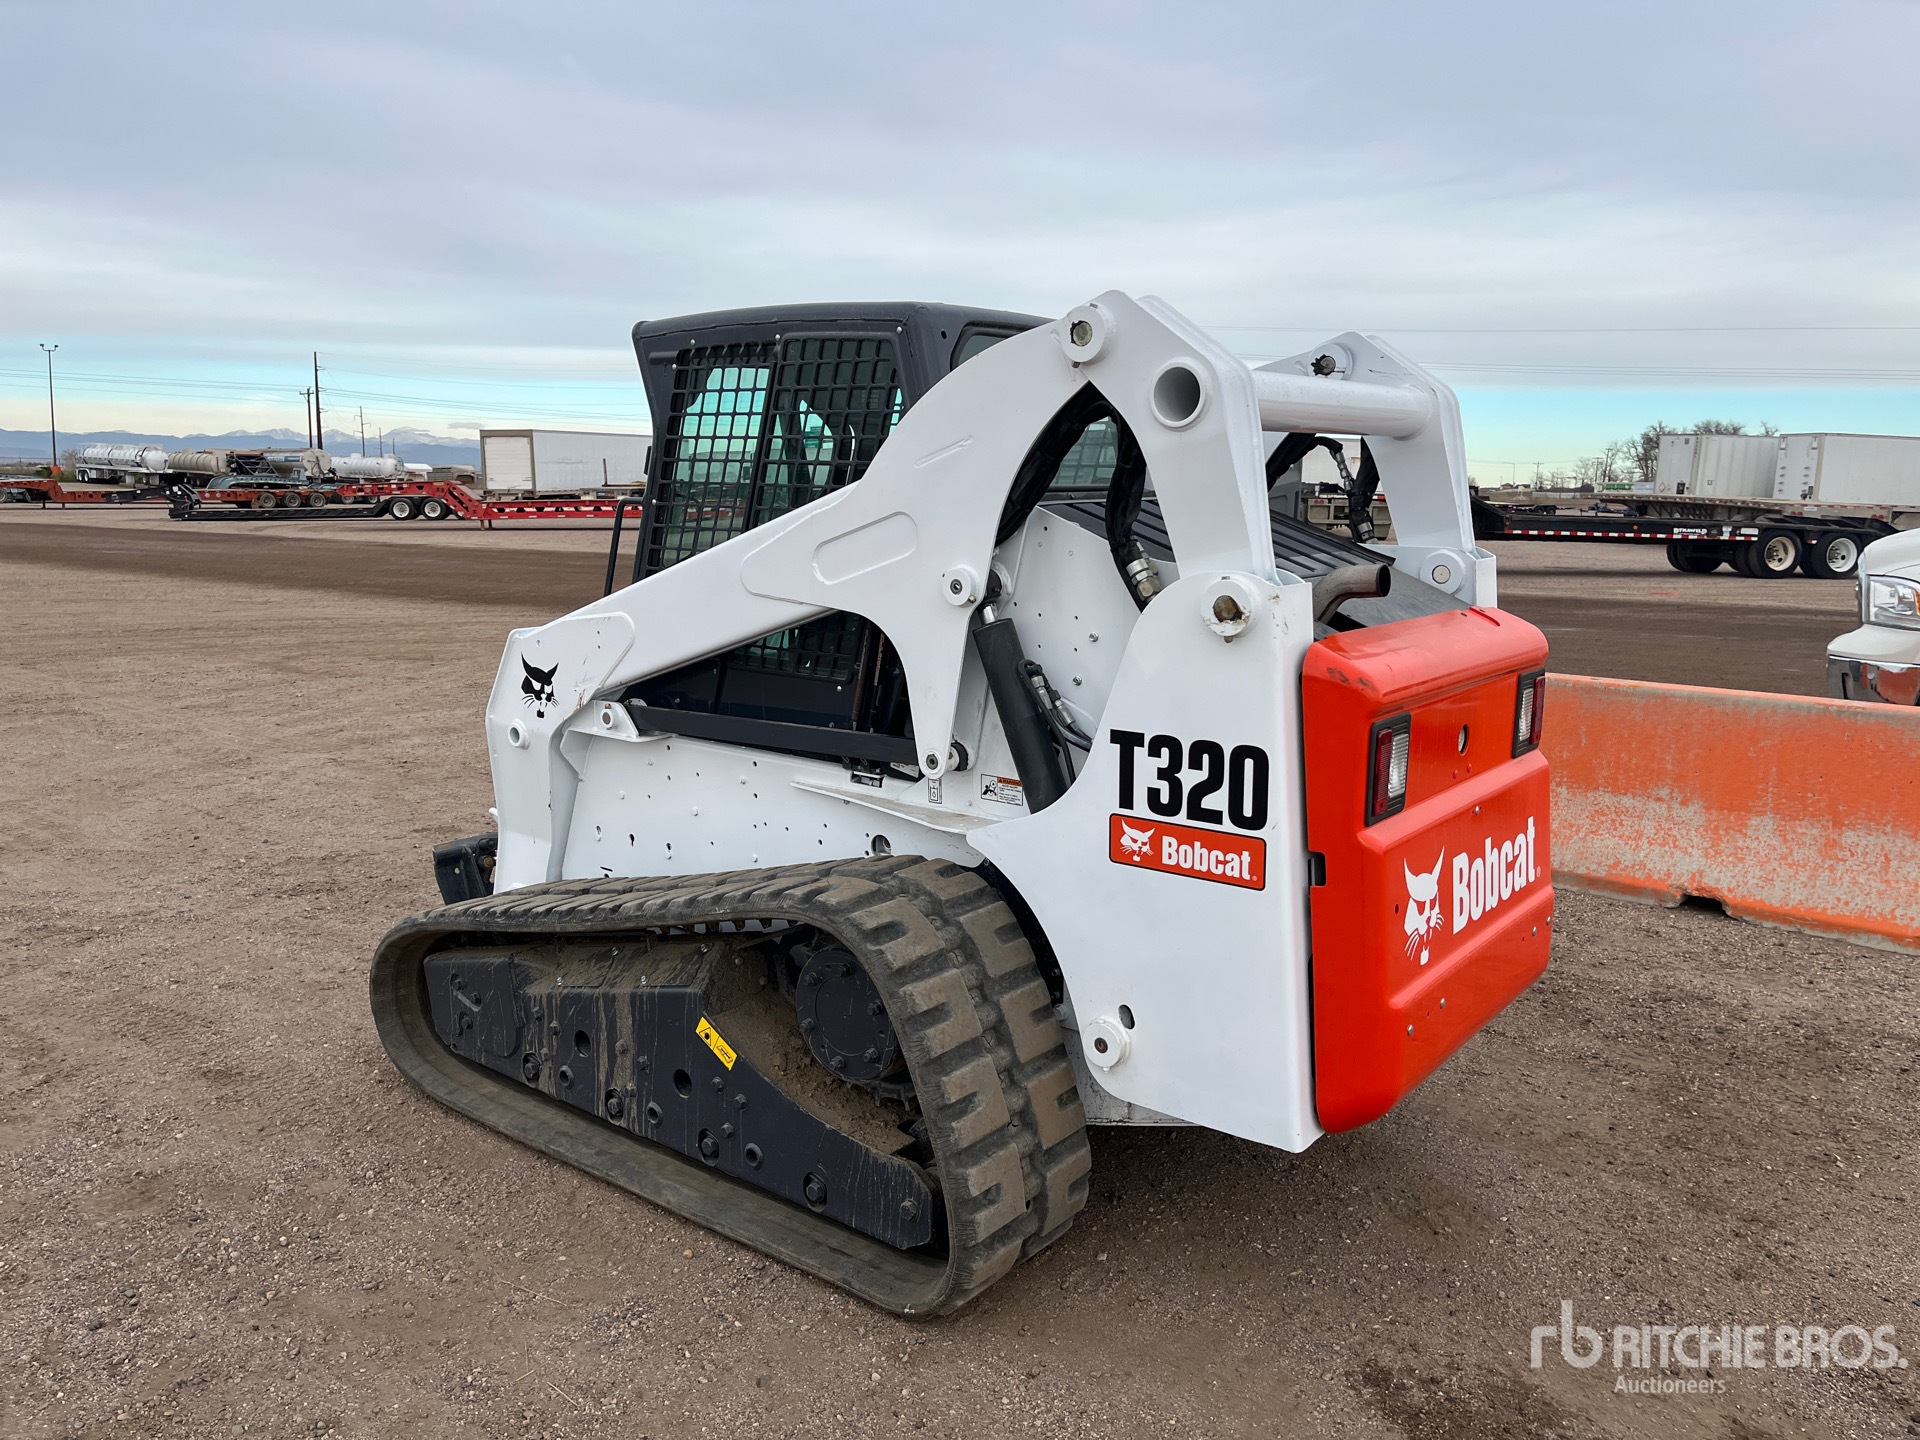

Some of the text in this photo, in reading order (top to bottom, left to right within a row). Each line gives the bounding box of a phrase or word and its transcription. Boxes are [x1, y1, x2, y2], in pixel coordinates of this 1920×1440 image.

[1110, 729, 1269, 831] T320
[1161, 835, 1251, 881] Bobcat
[1452, 815, 1536, 935] Bobcat
